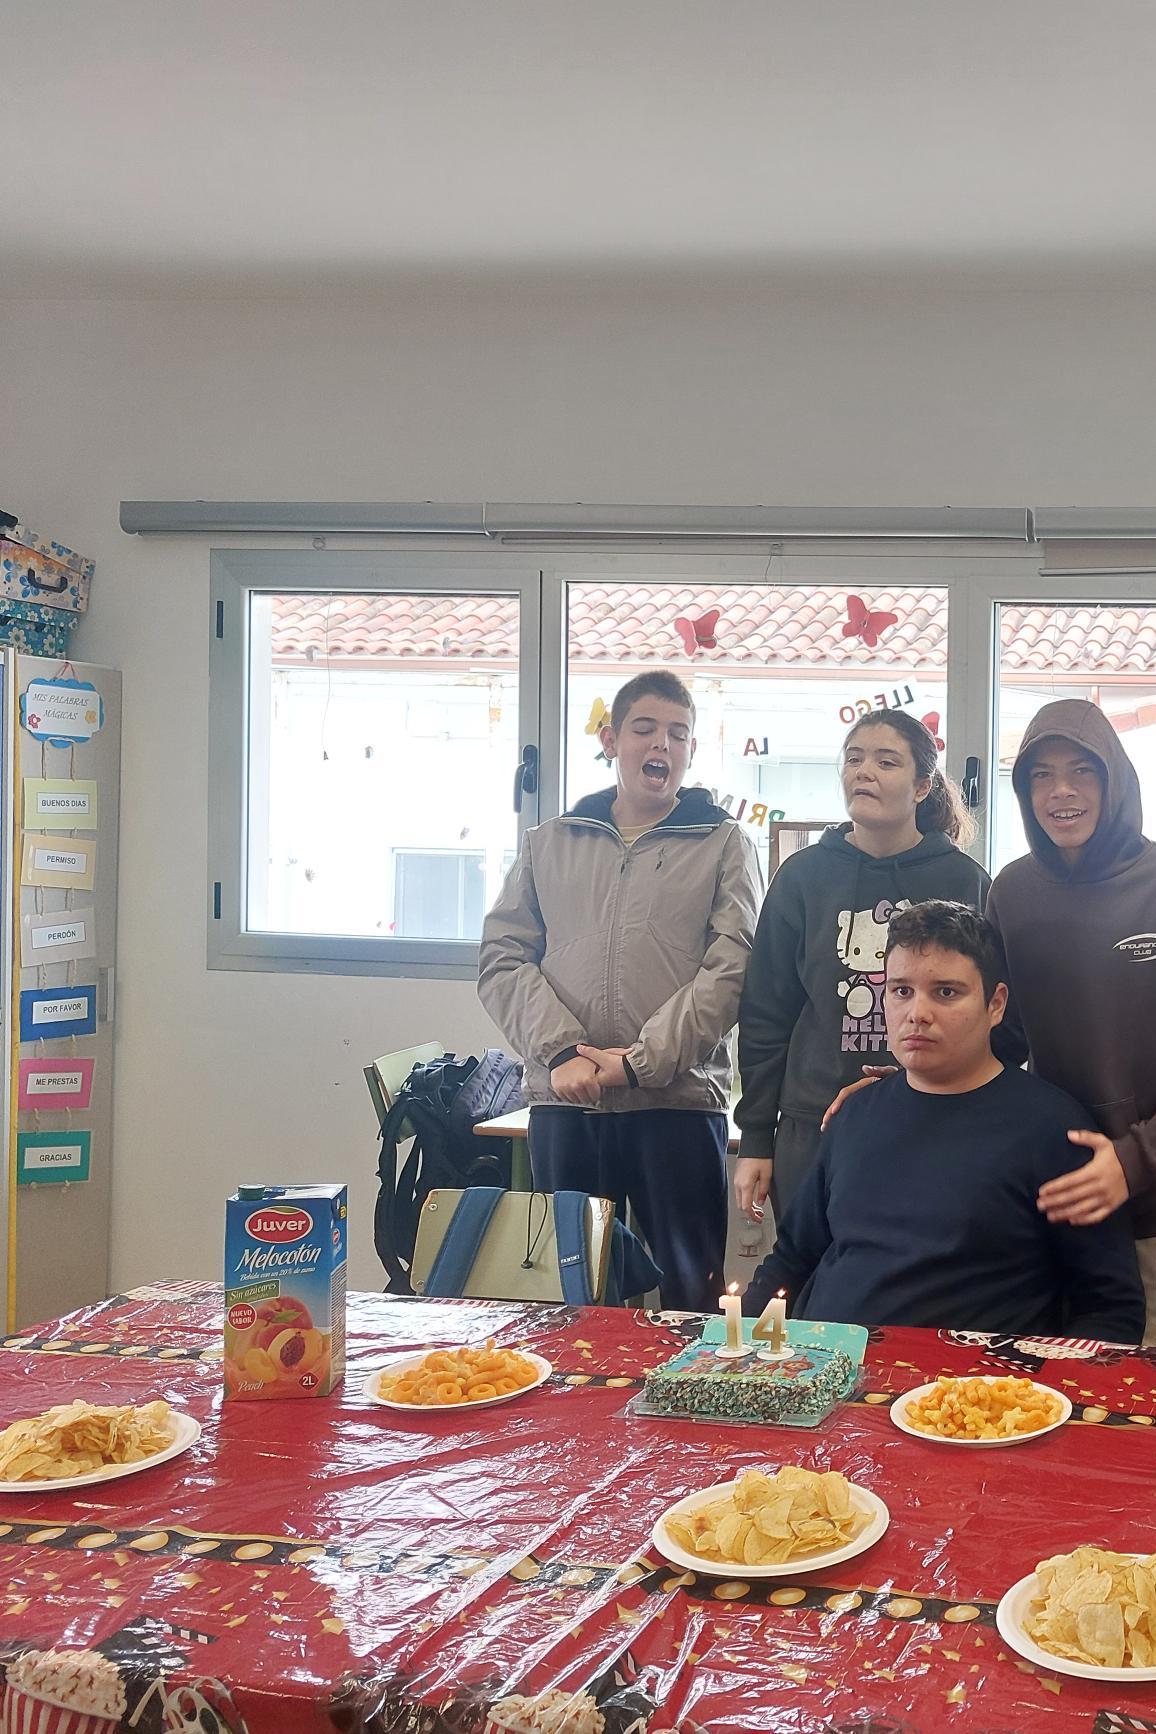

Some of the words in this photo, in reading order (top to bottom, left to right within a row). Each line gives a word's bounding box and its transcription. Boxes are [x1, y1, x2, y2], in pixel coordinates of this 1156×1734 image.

[33, 693, 48, 702] MIS
[48, 695, 89, 706] PALABRAS
[42, 799, 70, 807] BUENOS
[46, 855, 76, 865] PERMISO
[47, 929, 76, 940] PERDÓN
[43, 1005, 58, 1014] POR
[60, 1002, 82, 1012] FAVOR
[842, 1015, 888, 1033] HEL
[841, 1034, 892, 1052] KITT
[47, 1078, 78, 1086] PRESTAS
[39, 1154, 72, 1162] GRACIAS
[253, 1218, 306, 1232] Juver
[234, 1244, 322, 1272] Melocotón
[230, 1291, 244, 1302] Sin
[302, 1376, 315, 1386] 2L
